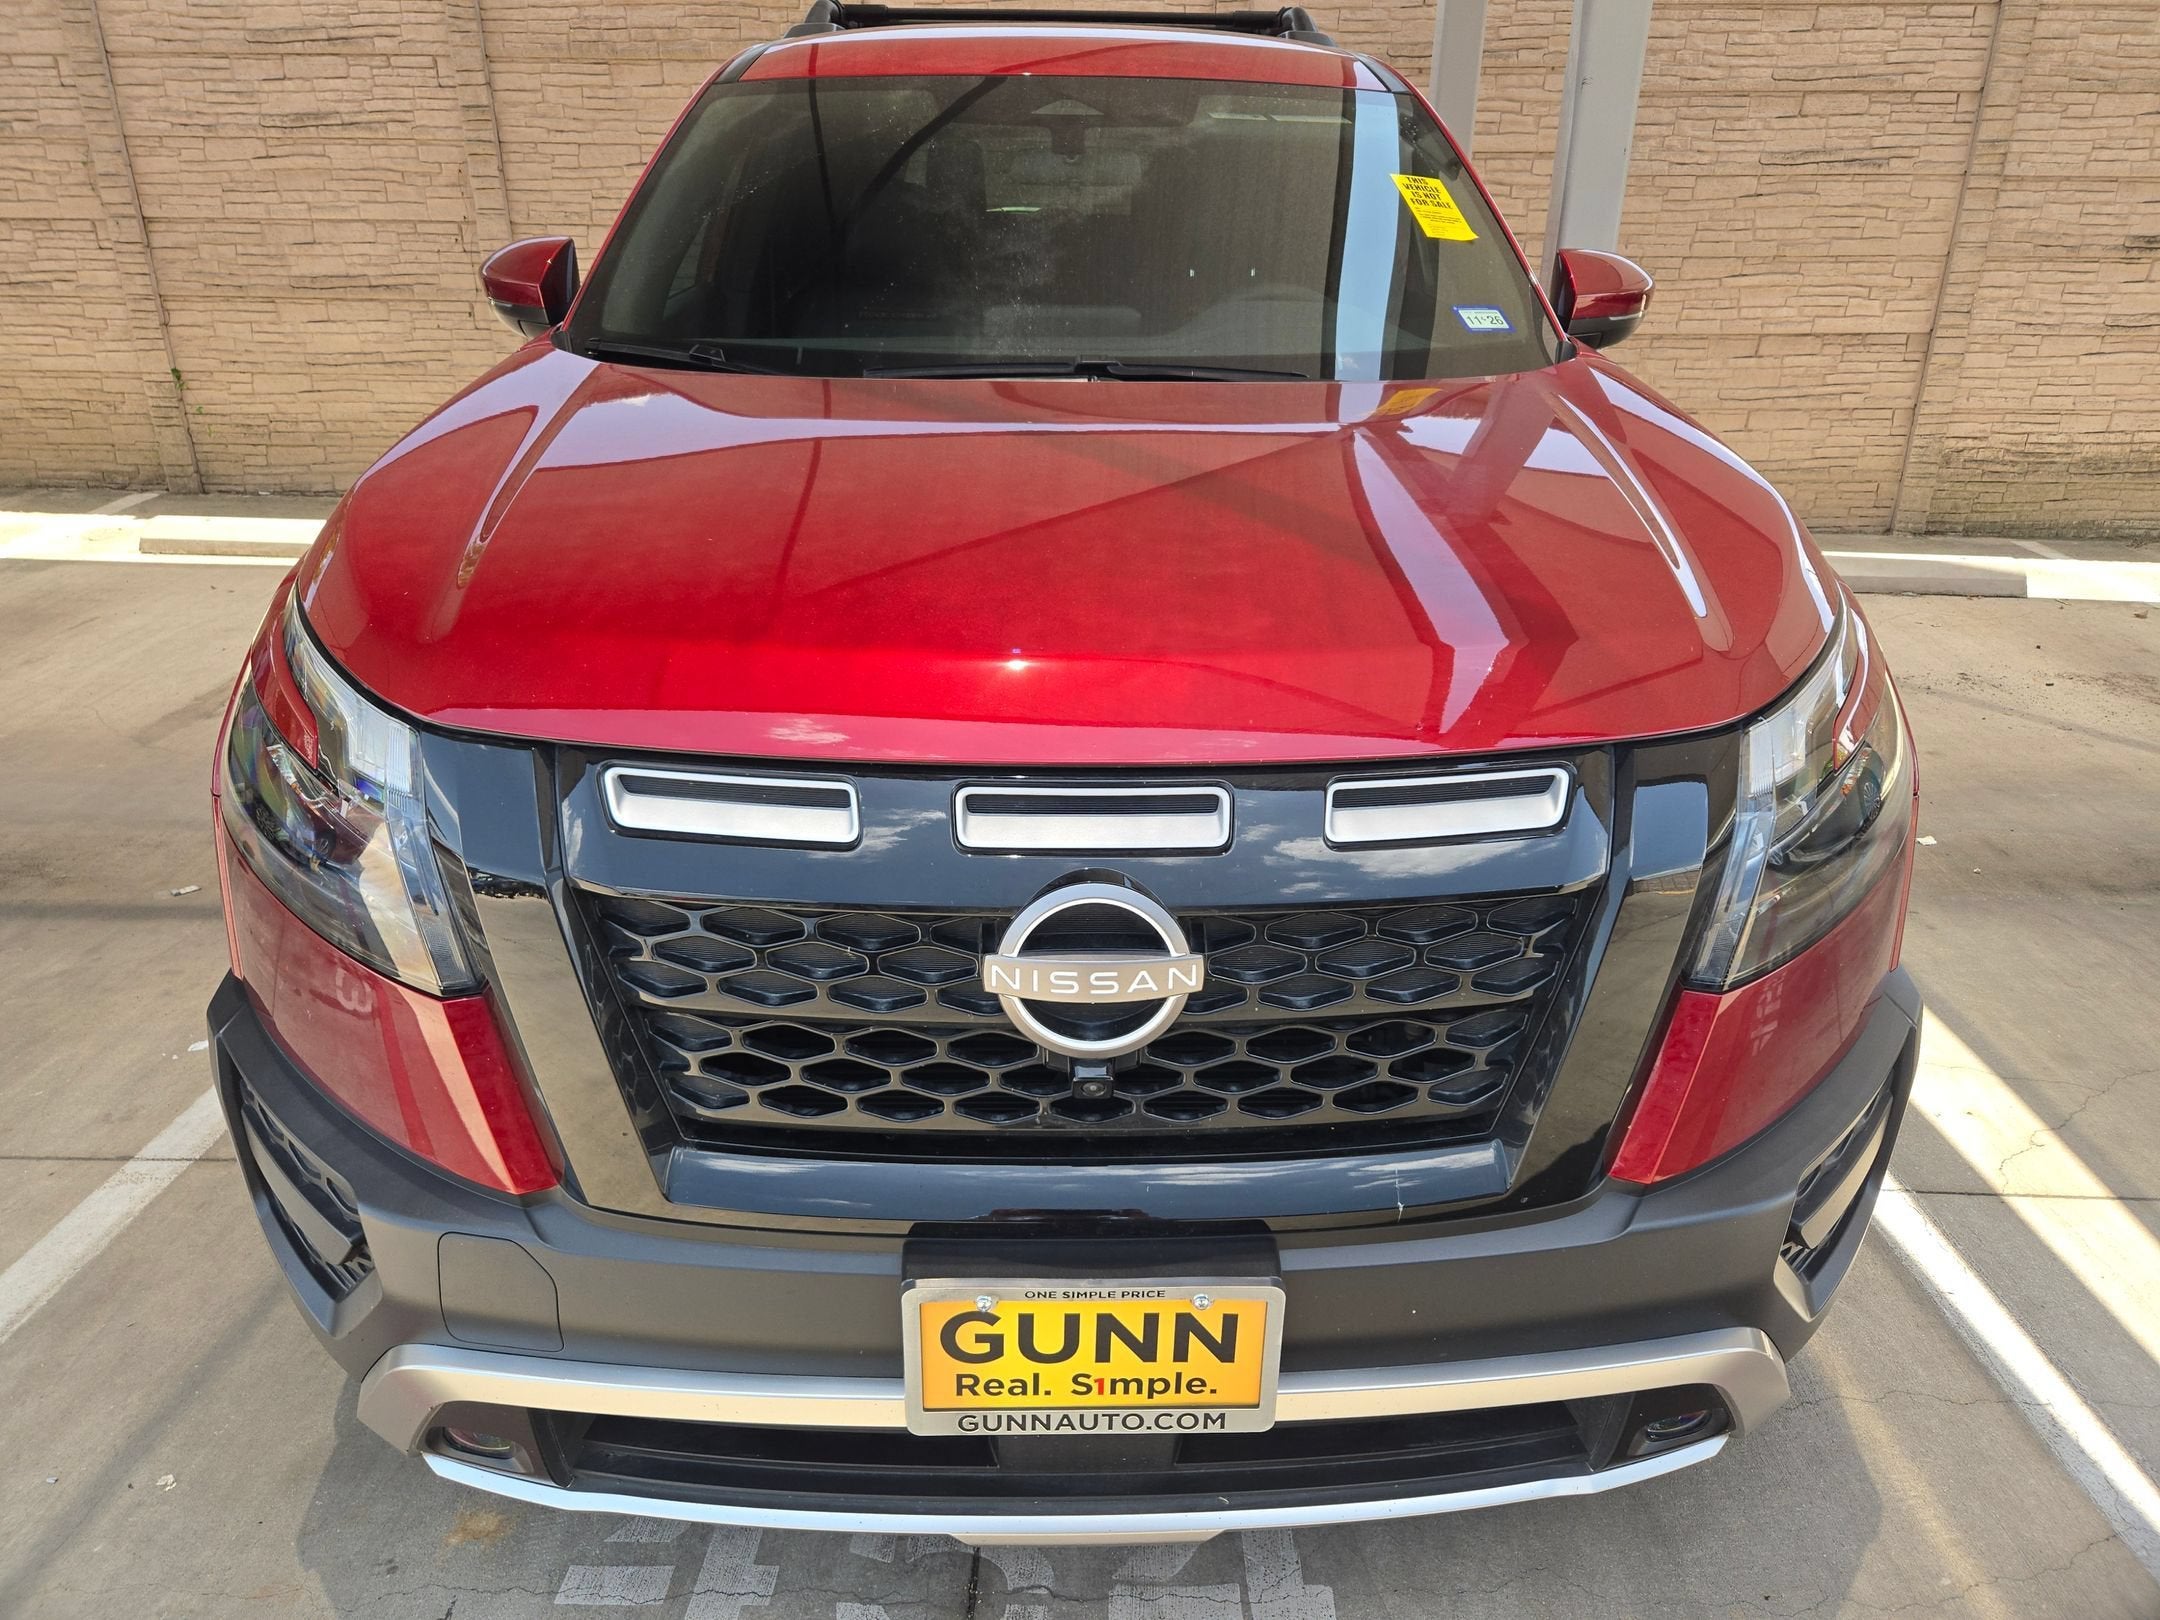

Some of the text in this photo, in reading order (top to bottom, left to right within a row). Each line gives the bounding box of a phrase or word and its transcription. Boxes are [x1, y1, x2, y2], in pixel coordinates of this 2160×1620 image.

[1406, 176, 1428, 186] THIS
[1403, 183, 1441, 194] VEHICLE
[1411, 190, 1441, 200] IS NOT
[1410, 198, 1453, 210] FOR SALE
[991, 964, 1197, 995] NISSAN
[1025, 1290, 1166, 1299] ONE SIMPLE PRICE
[940, 1310, 1238, 1364] GUNN
[955, 1373, 1052, 1397] Real.
[957, 1412, 1226, 1432] GUNNAUTO.COM
